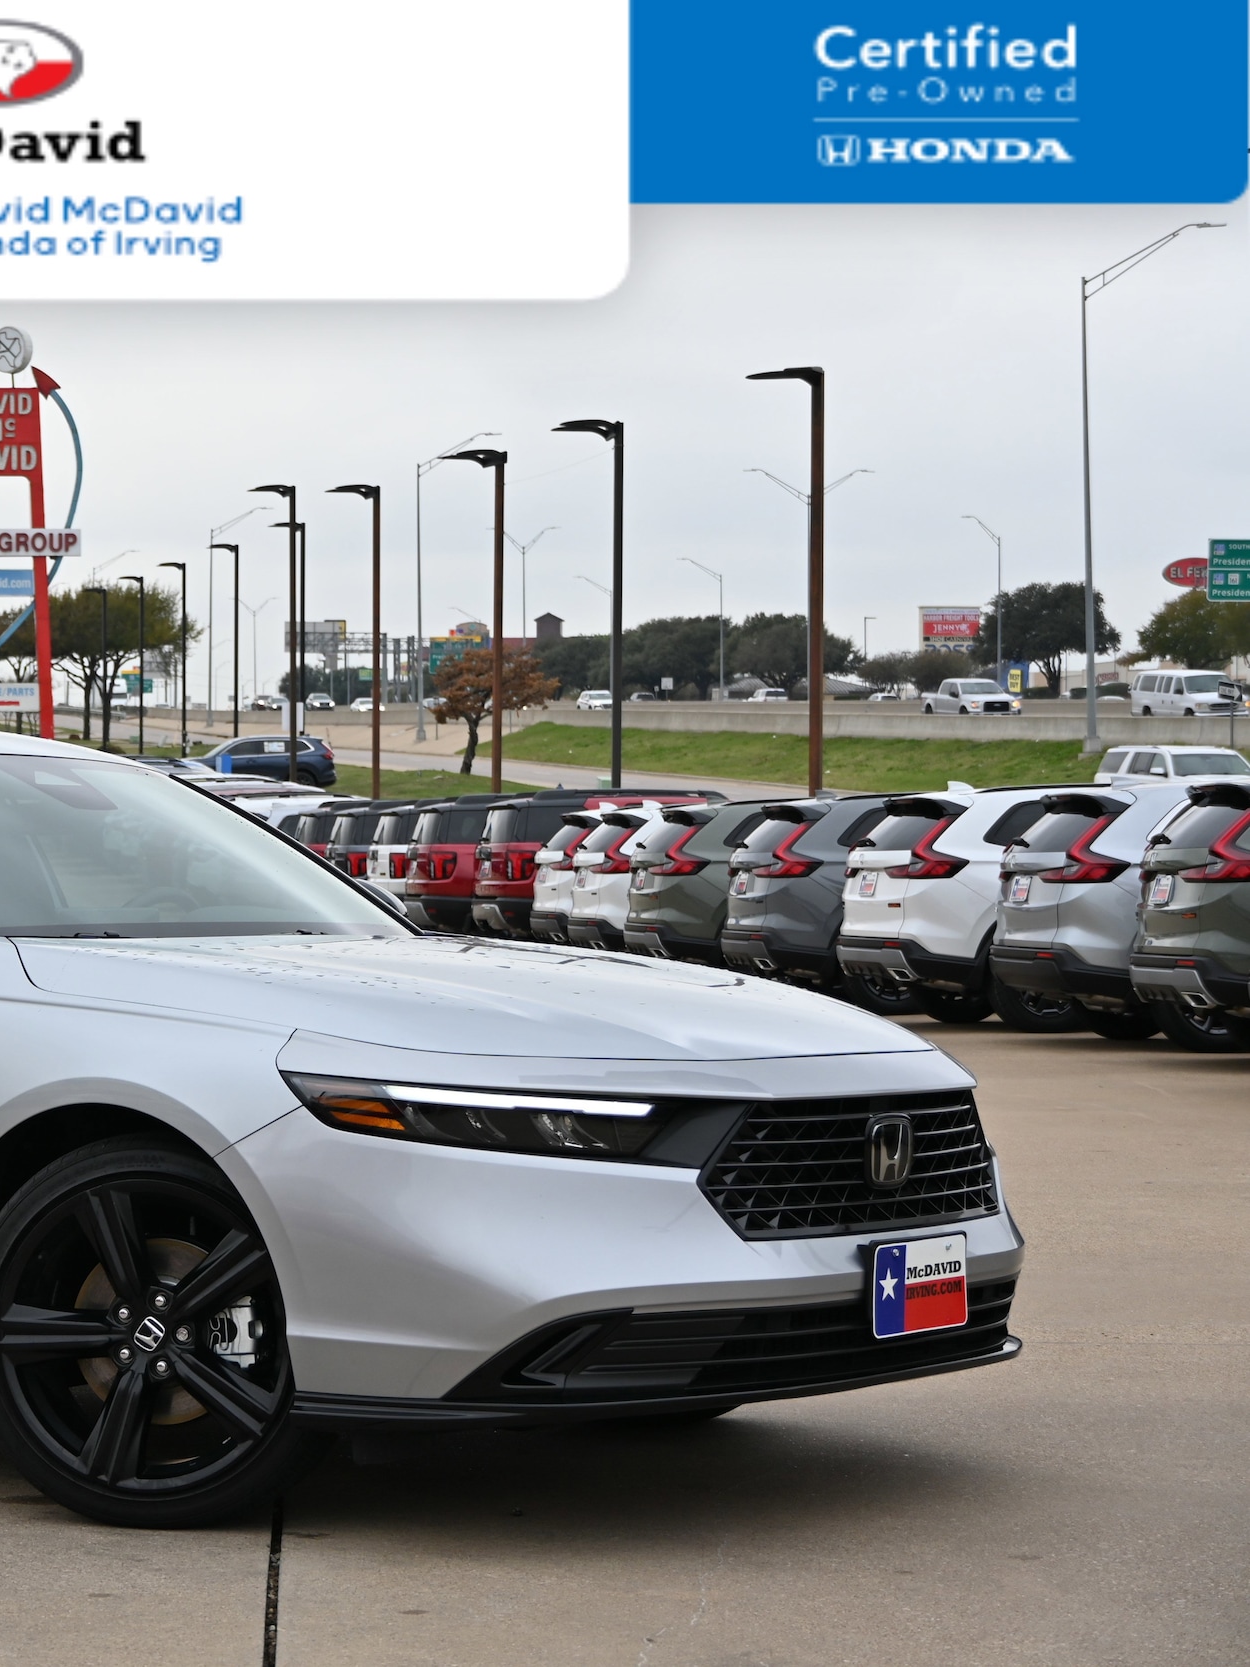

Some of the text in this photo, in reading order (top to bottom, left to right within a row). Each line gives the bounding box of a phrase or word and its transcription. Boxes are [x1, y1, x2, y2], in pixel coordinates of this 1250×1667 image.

[1170, 567, 1184, 578] EL
[906, 1260, 961, 1280] McDAVID
[906, 1280, 962, 1300] IRVING.COM
